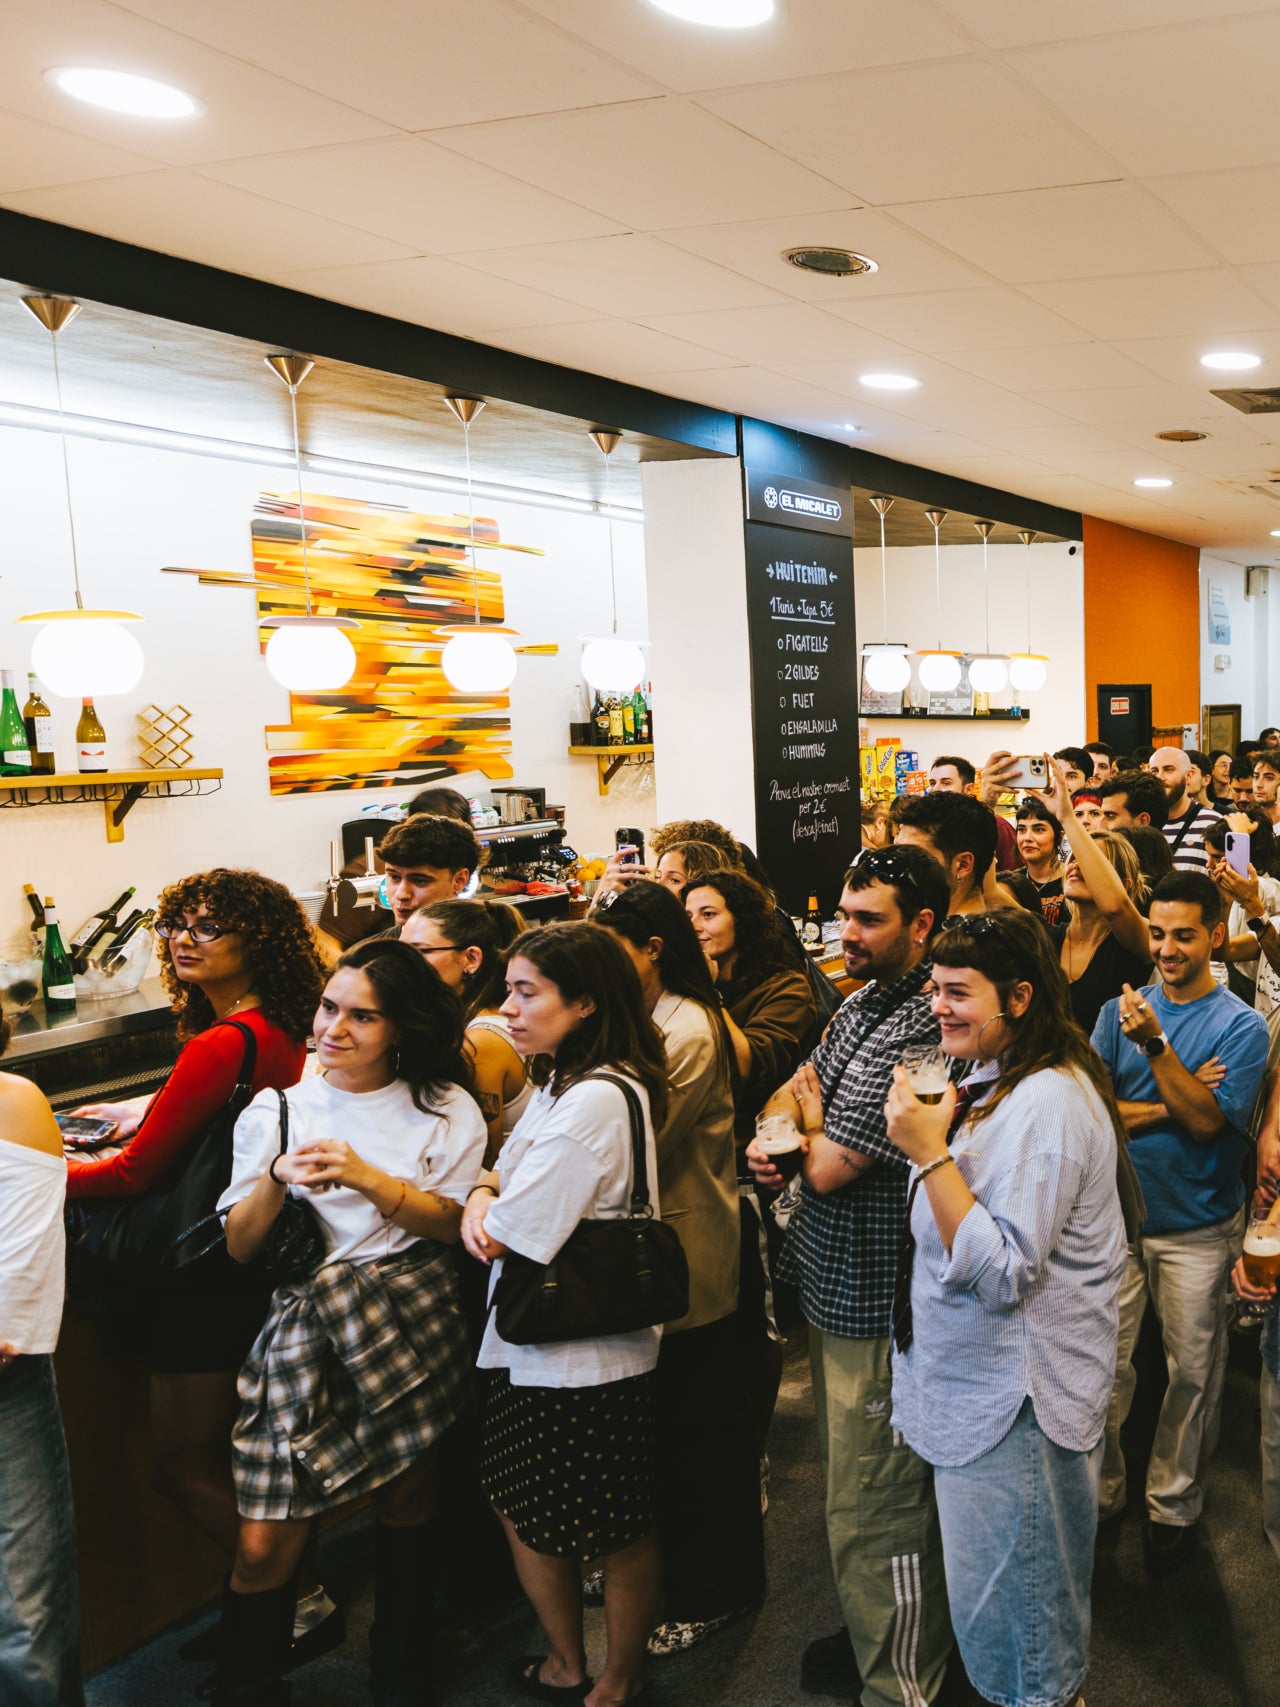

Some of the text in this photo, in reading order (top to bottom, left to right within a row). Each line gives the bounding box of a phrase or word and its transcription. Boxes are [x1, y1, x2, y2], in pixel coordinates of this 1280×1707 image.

[781, 494, 839, 517] EL MICALET
[820, 600, 834, 618] 5€
[785, 633, 829, 652] FIGATELLS
[792, 692, 815, 709] FUET
[787, 718, 838, 735] ENSALADILLA
[788, 742, 826, 760] HUMMUS
[769, 779, 792, 801] Prova
[792, 781, 802, 799] el
[798, 798, 827, 817] per 2€
